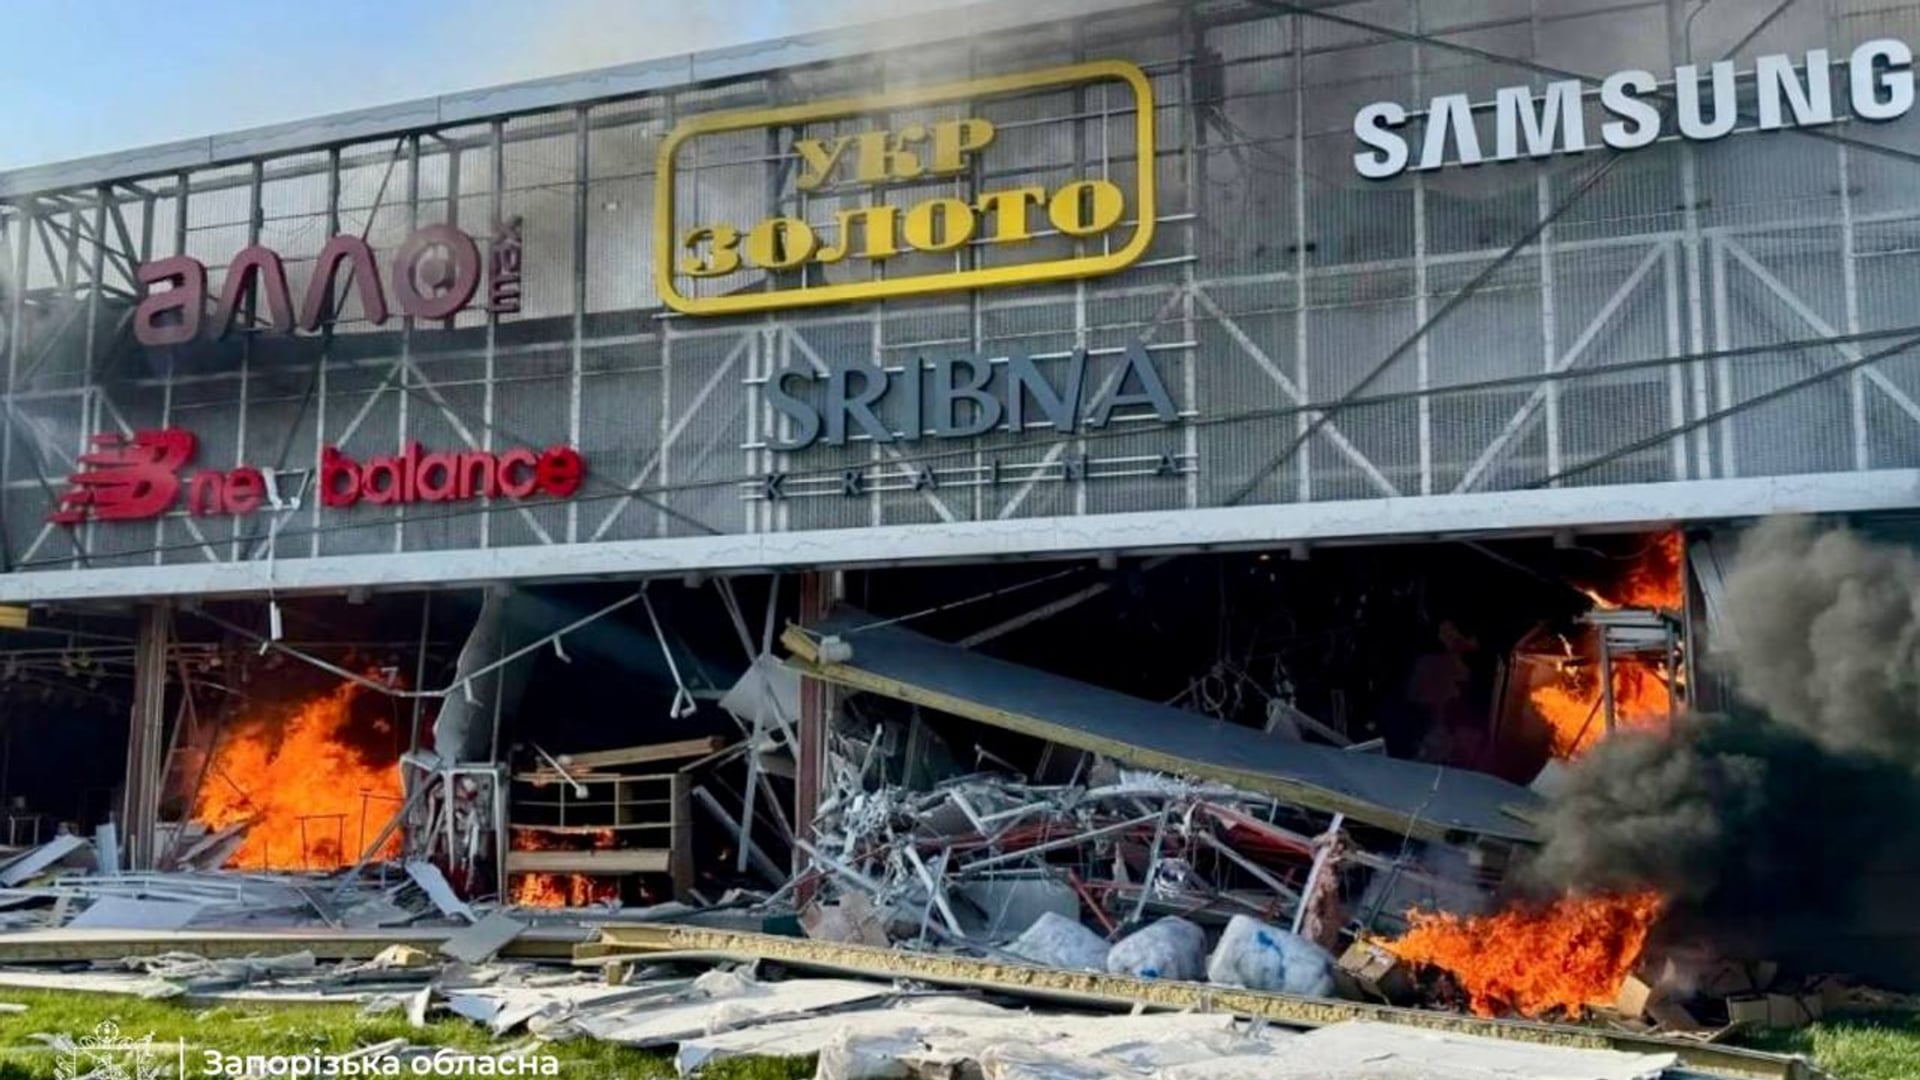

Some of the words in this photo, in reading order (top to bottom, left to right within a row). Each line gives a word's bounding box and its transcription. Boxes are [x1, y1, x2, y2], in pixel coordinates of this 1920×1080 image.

[793, 118, 996, 190] УКР
[1353, 39, 1915, 178] SAMSUNG
[489, 215, 523, 313] max
[682, 179, 1124, 277] ЗОЛОТО
[766, 342, 1181, 452] SRIBNA
[321, 440, 584, 508] balance
[763, 449, 1186, 501] KRAINA
